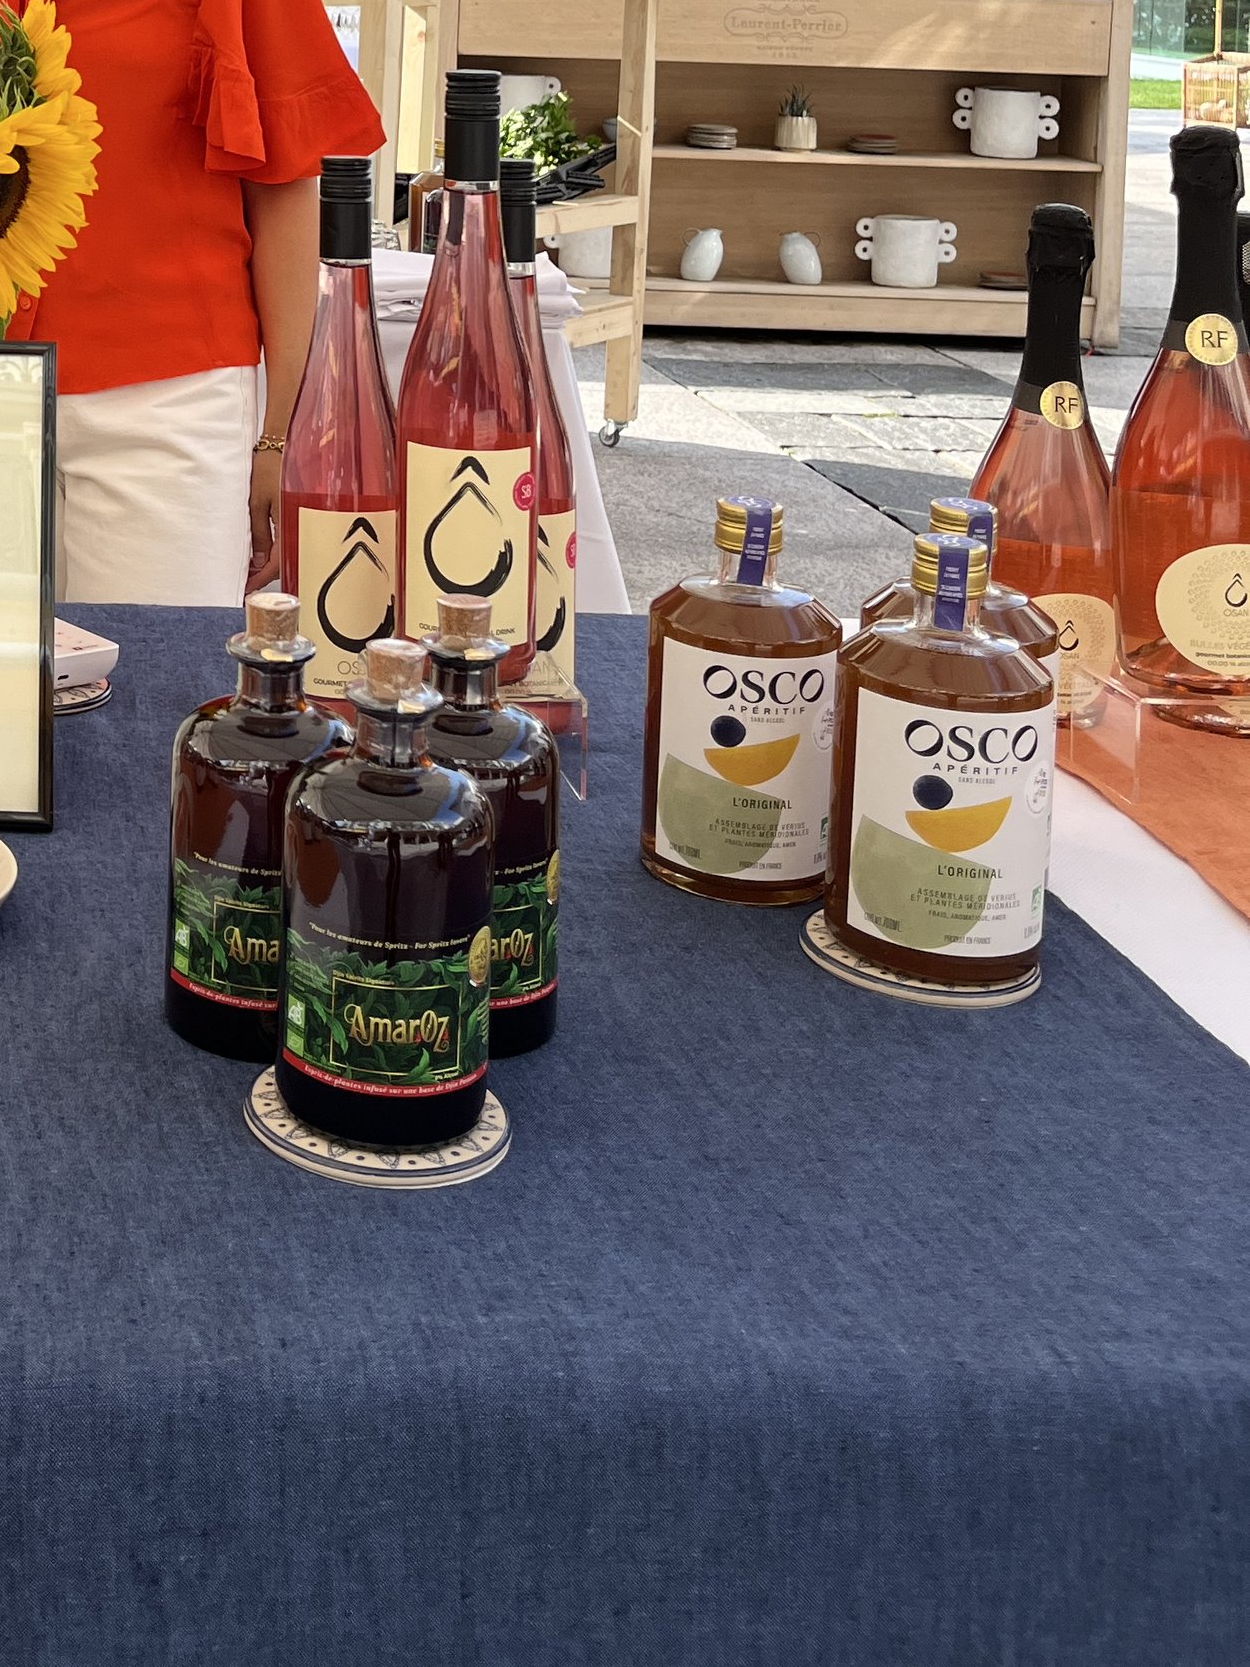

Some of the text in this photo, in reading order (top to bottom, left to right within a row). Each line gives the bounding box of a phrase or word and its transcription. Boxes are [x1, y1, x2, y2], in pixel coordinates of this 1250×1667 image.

[730, 16, 842, 32] Laurent-Perrier
[1201, 329, 1230, 348] RF
[1054, 395, 1080, 414] RF
[1223, 608, 1249, 617] OSAN
[496, 626, 516, 635] DRINK
[1190, 639, 1225, 650] BULLES
[1195, 652, 1225, 660] gourmet
[313, 677, 347, 688] GOURMET
[703, 664, 825, 705] OSCO
[727, 704, 806, 715] APÉRITIF
[904, 719, 1038, 764] OSCO
[932, 762, 1019, 775] APÉRITIF
[732, 797, 793, 810] L'ORIGINAL
[709, 823, 718, 831] ET
[720, 827, 756, 838] PLANTES
[714, 817, 779, 831] ASSEMBLAGE DE
[218, 862, 249, 874] amateurs
[250, 867, 259, 875] de
[937, 864, 1003, 879] L'ORIGINAL
[910, 893, 921, 902] ET
[923, 895, 963, 909] PLANTES
[916, 887, 988, 902] ASSEMBLAGE DE
[991, 913, 1007, 921] AMER
[223, 924, 280, 966] Ama
[326, 928, 450, 951] les amateurs de Spritz For Spritz
[973, 936, 991, 945] FRANCE
[490, 928, 535, 967] arOz
[241, 998, 263, 1008] infusé
[343, 1003, 450, 1053] AmarOz
[304, 1064, 363, 1091] Esprit-de-plantes
[362, 1083, 387, 1095] infusé
[388, 1086, 402, 1094] sur
[418, 1085, 435, 1095] base
[435, 1084, 445, 1093] de
